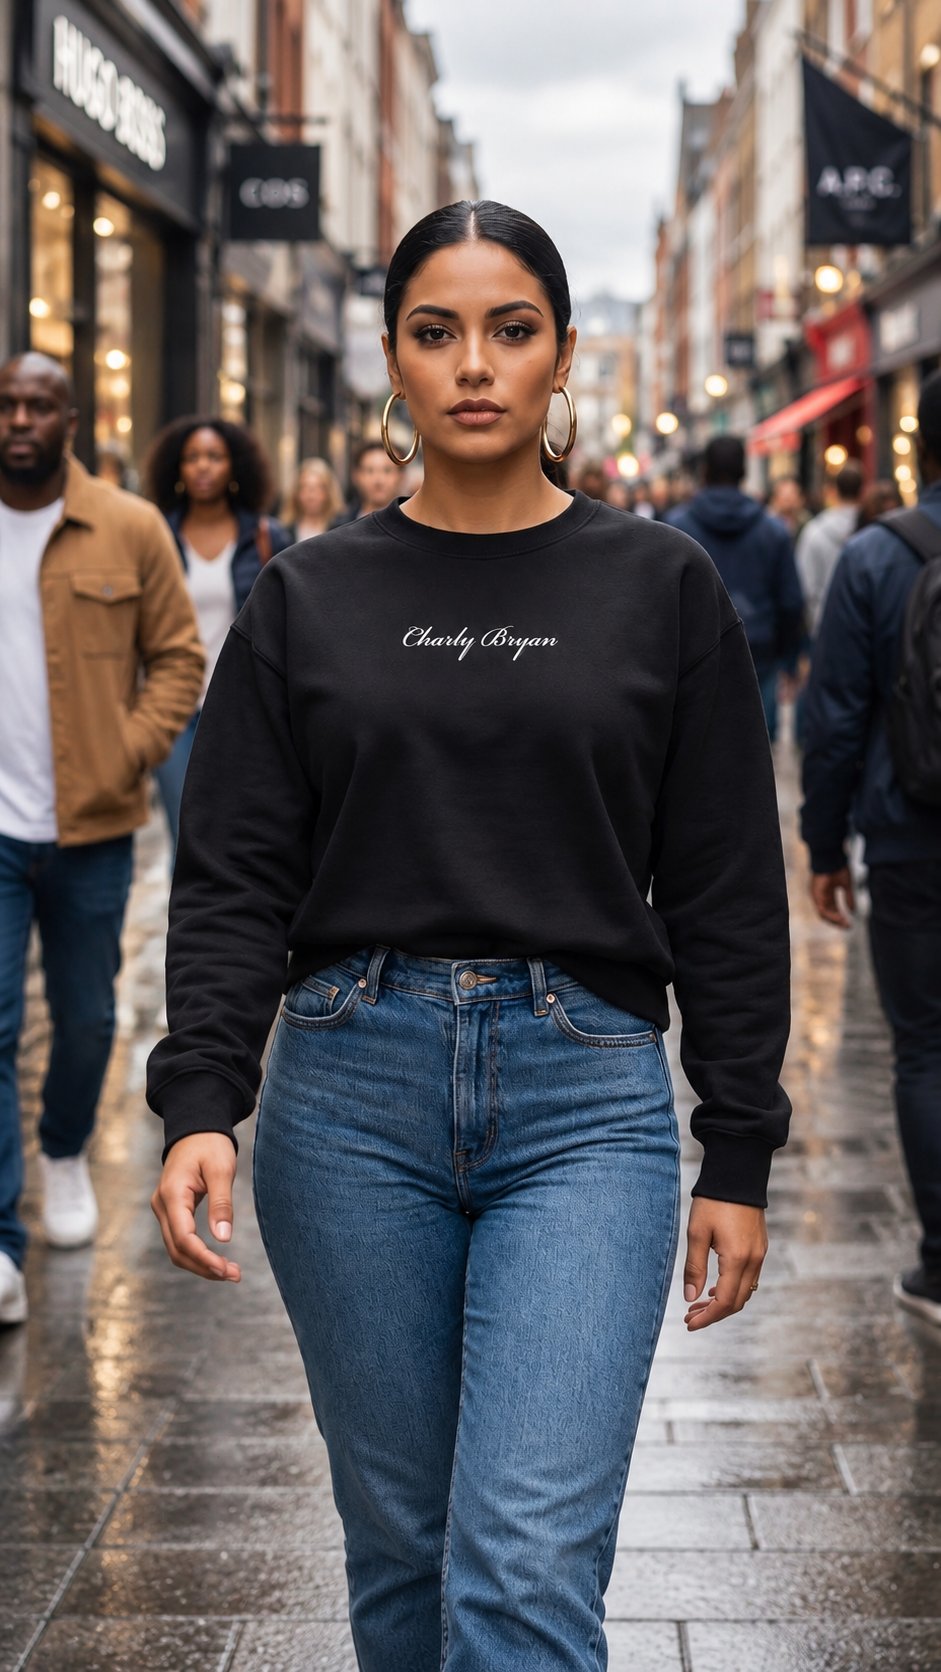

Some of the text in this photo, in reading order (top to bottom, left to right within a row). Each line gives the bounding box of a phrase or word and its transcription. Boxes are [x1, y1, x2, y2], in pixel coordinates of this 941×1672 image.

[54, 15, 118, 131] HUGO
[239, 177, 309, 209] COS
[402, 625, 559, 661] Charly Bryan
